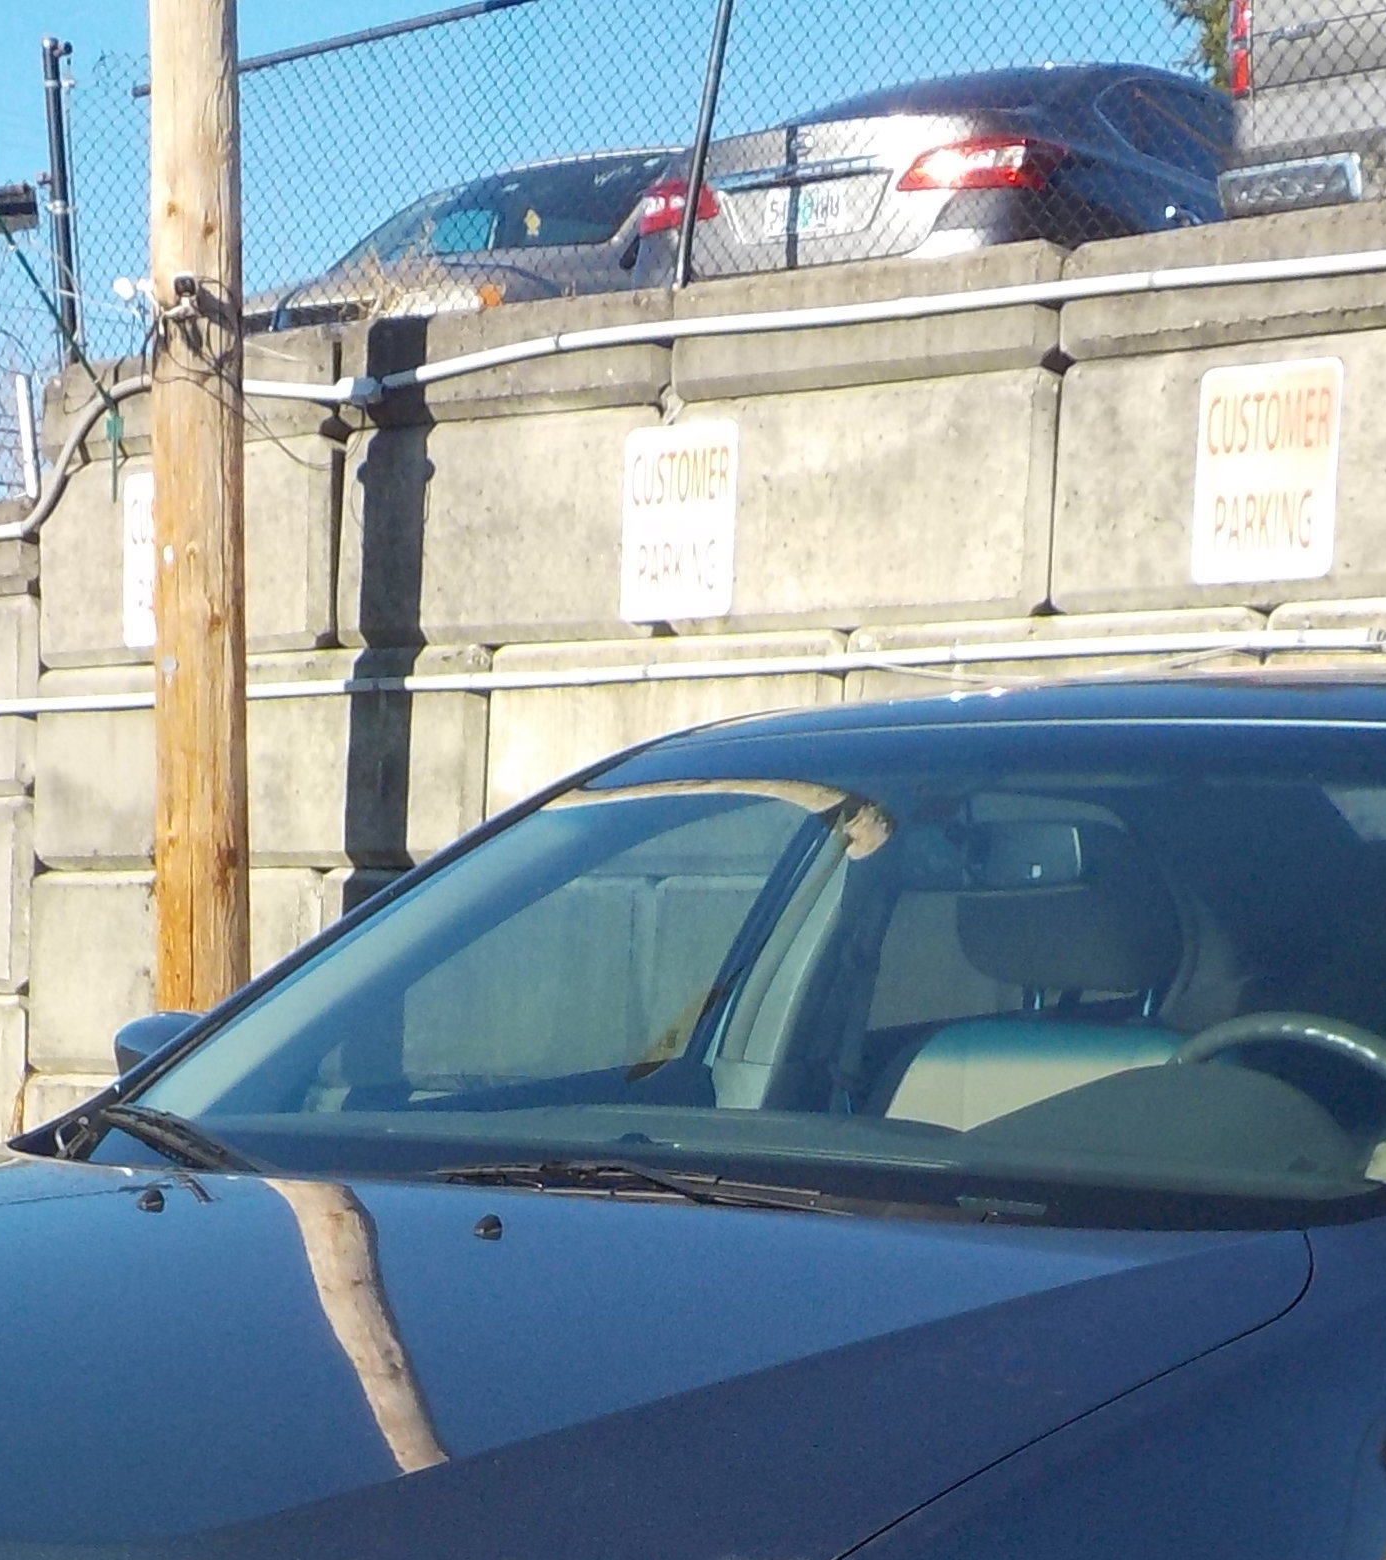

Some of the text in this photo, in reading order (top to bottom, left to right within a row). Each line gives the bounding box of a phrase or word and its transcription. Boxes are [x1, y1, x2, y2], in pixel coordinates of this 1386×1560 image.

[1206, 386, 1332, 456] CUSTOMER
[631, 445, 729, 507] CUSTOMER
[1213, 488, 1313, 551] PARKING
[638, 538, 718, 591] PARKNG
